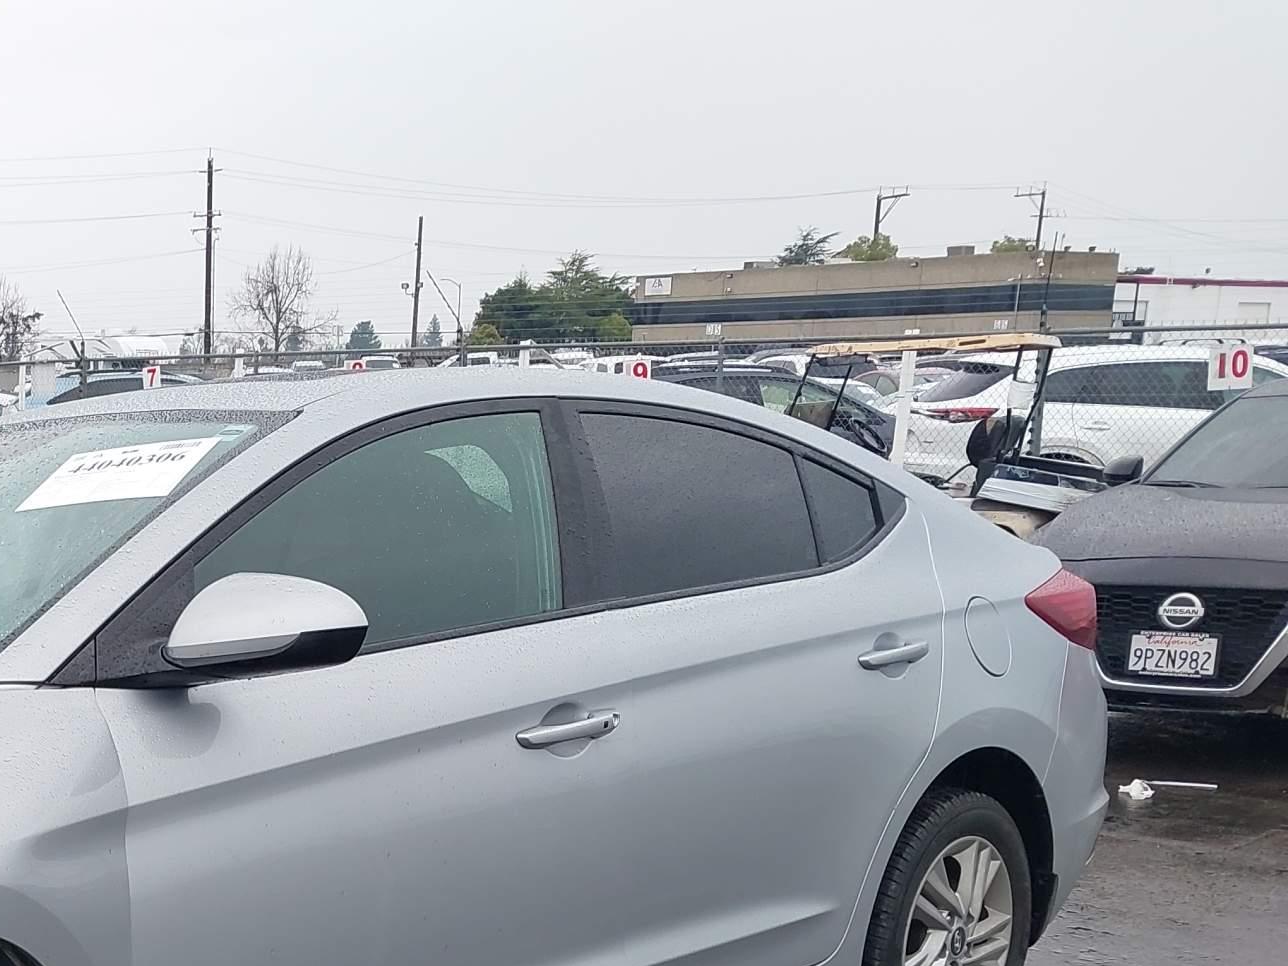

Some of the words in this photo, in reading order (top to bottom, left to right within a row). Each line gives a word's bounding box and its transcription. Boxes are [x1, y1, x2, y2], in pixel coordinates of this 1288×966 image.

[1218, 350, 1249, 378] 10
[147, 367, 157, 387] 7
[68, 451, 187, 474] 44040306
[1146, 635, 1198, 647] California
[1132, 647, 1212, 671] 9PZN982
